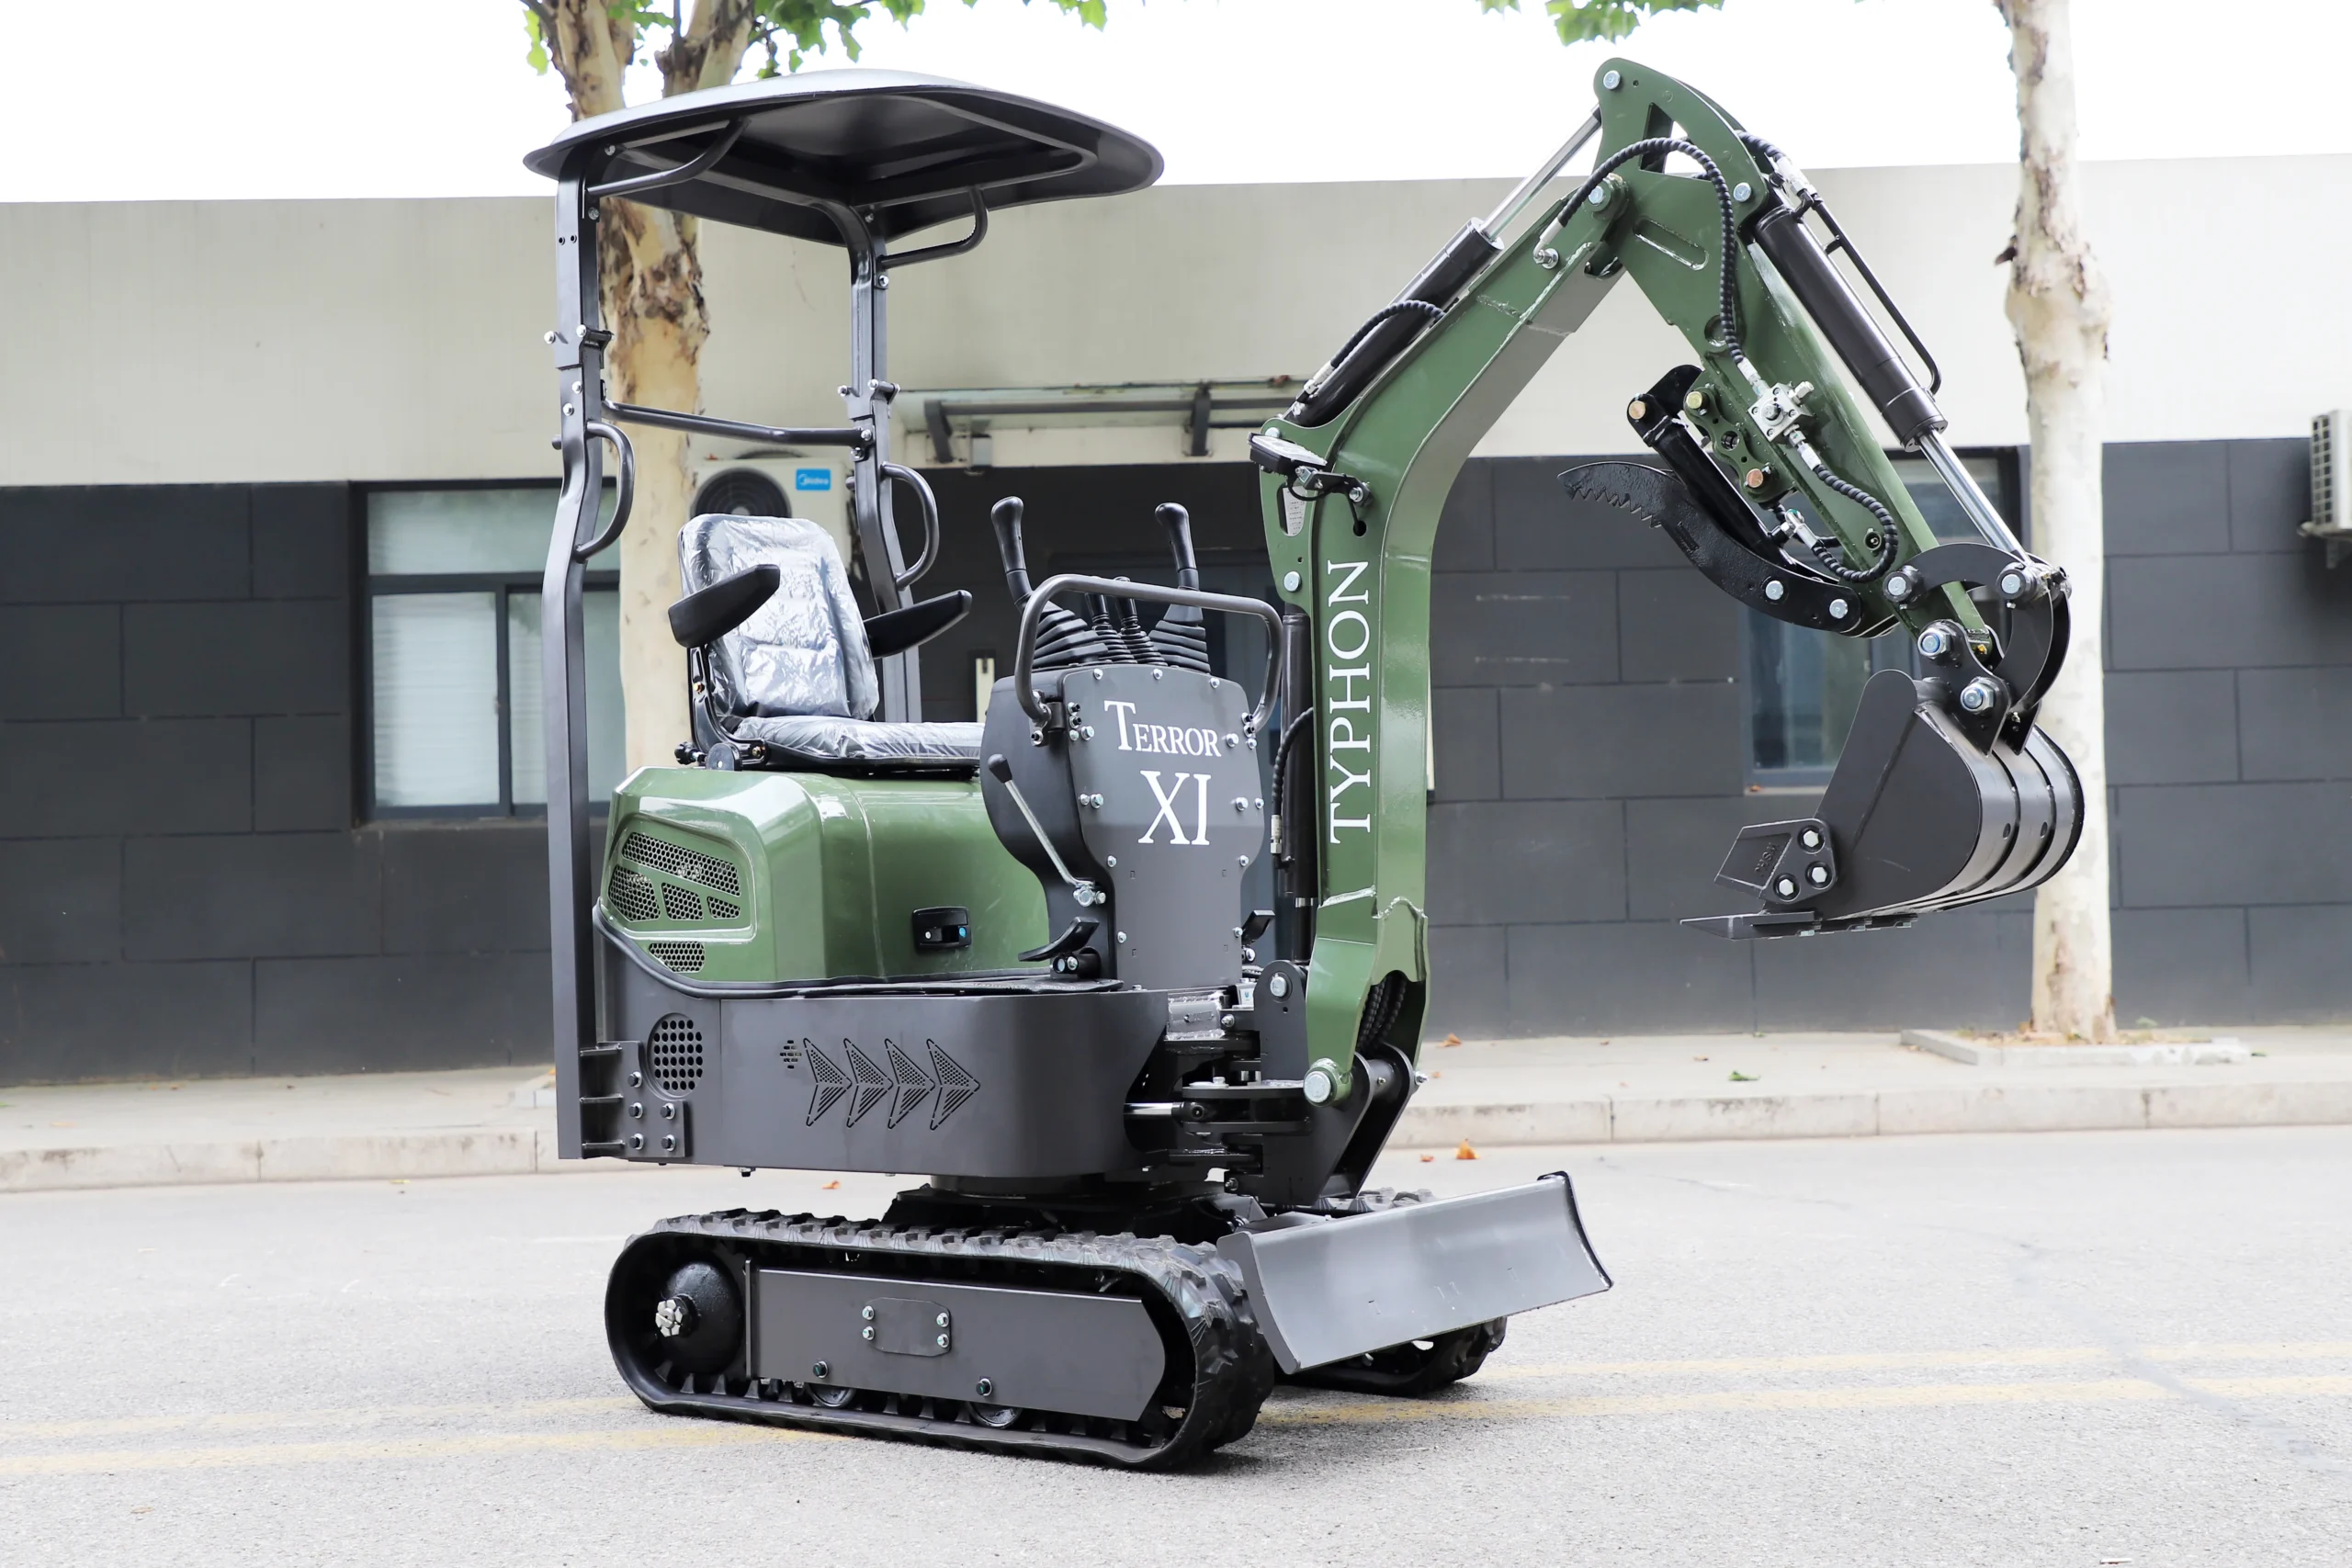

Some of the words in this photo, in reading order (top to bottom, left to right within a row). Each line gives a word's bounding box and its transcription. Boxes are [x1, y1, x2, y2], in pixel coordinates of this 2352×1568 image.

[1104, 700, 1222, 758] TERROR
[1327, 559, 1371, 844] TYPHON
[1137, 770, 1212, 846] XI
